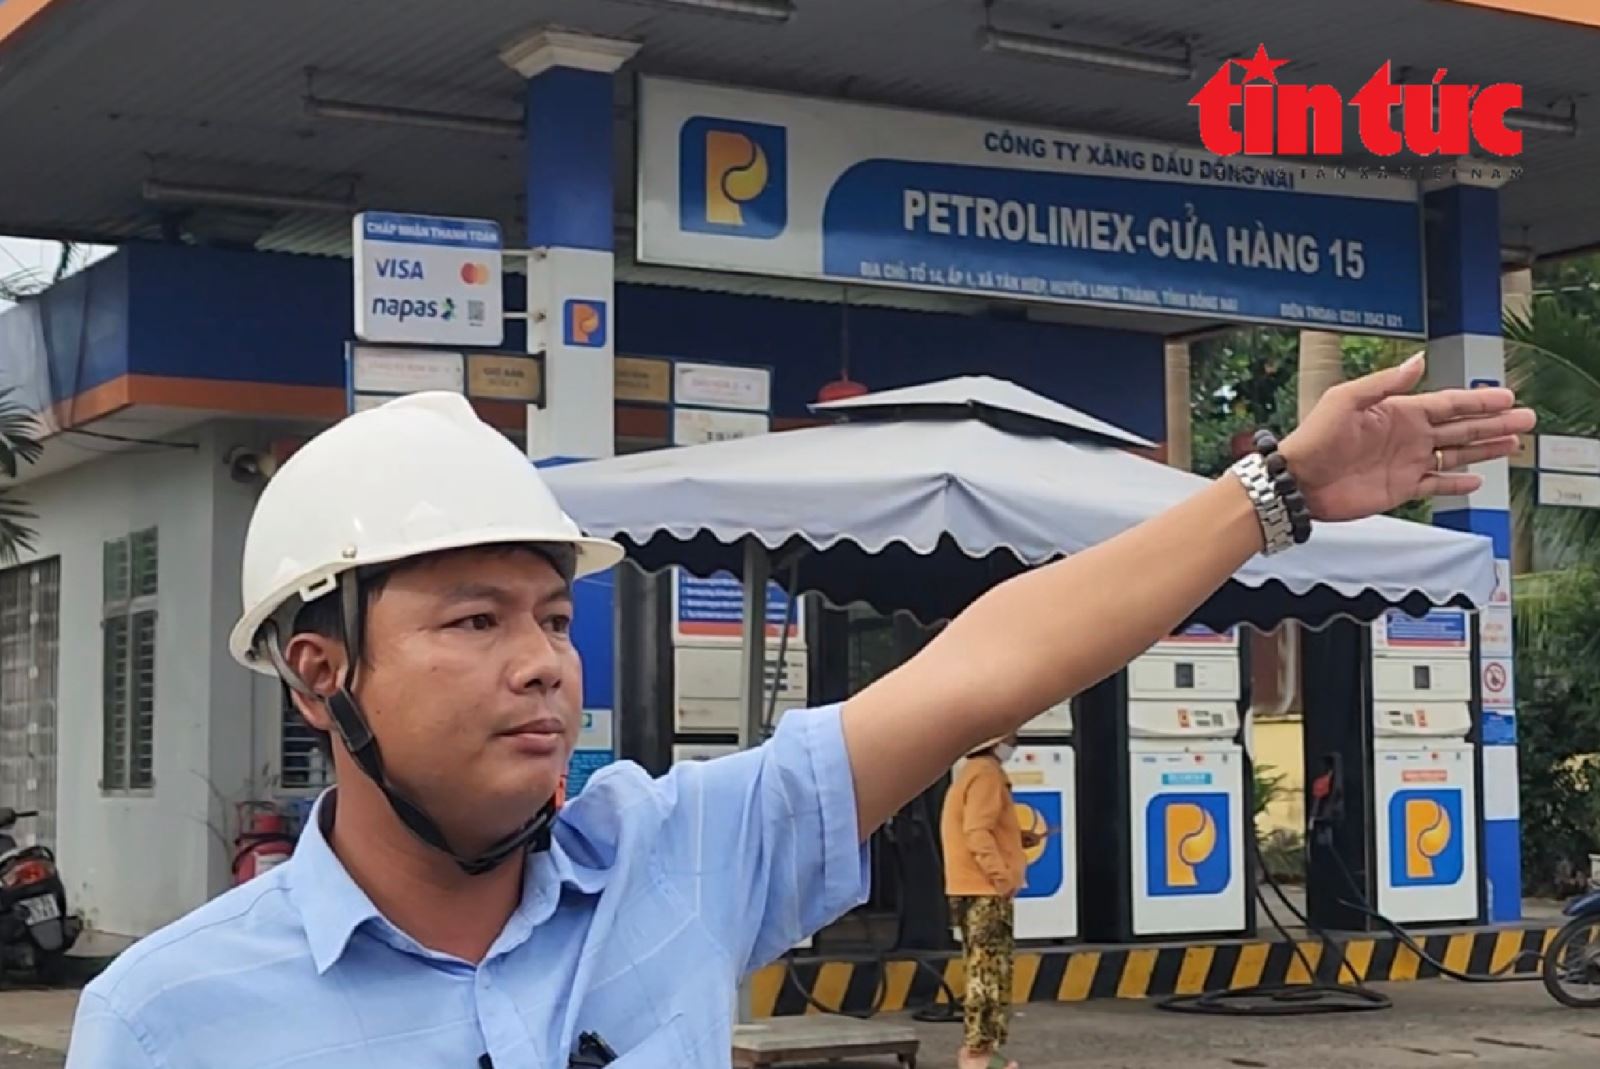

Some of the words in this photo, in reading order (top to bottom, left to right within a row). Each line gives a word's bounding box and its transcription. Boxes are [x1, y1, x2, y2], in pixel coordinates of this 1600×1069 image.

[984, 129, 1047, 158] CÔNG
[1053, 141, 1080, 162] TY
[1087, 144, 1146, 170] XĂNG
[1226, 221, 1320, 274] HÀNG
[1328, 239, 1365, 280] 15
[375, 258, 424, 279] VISA
[372, 297, 438, 322] napas
